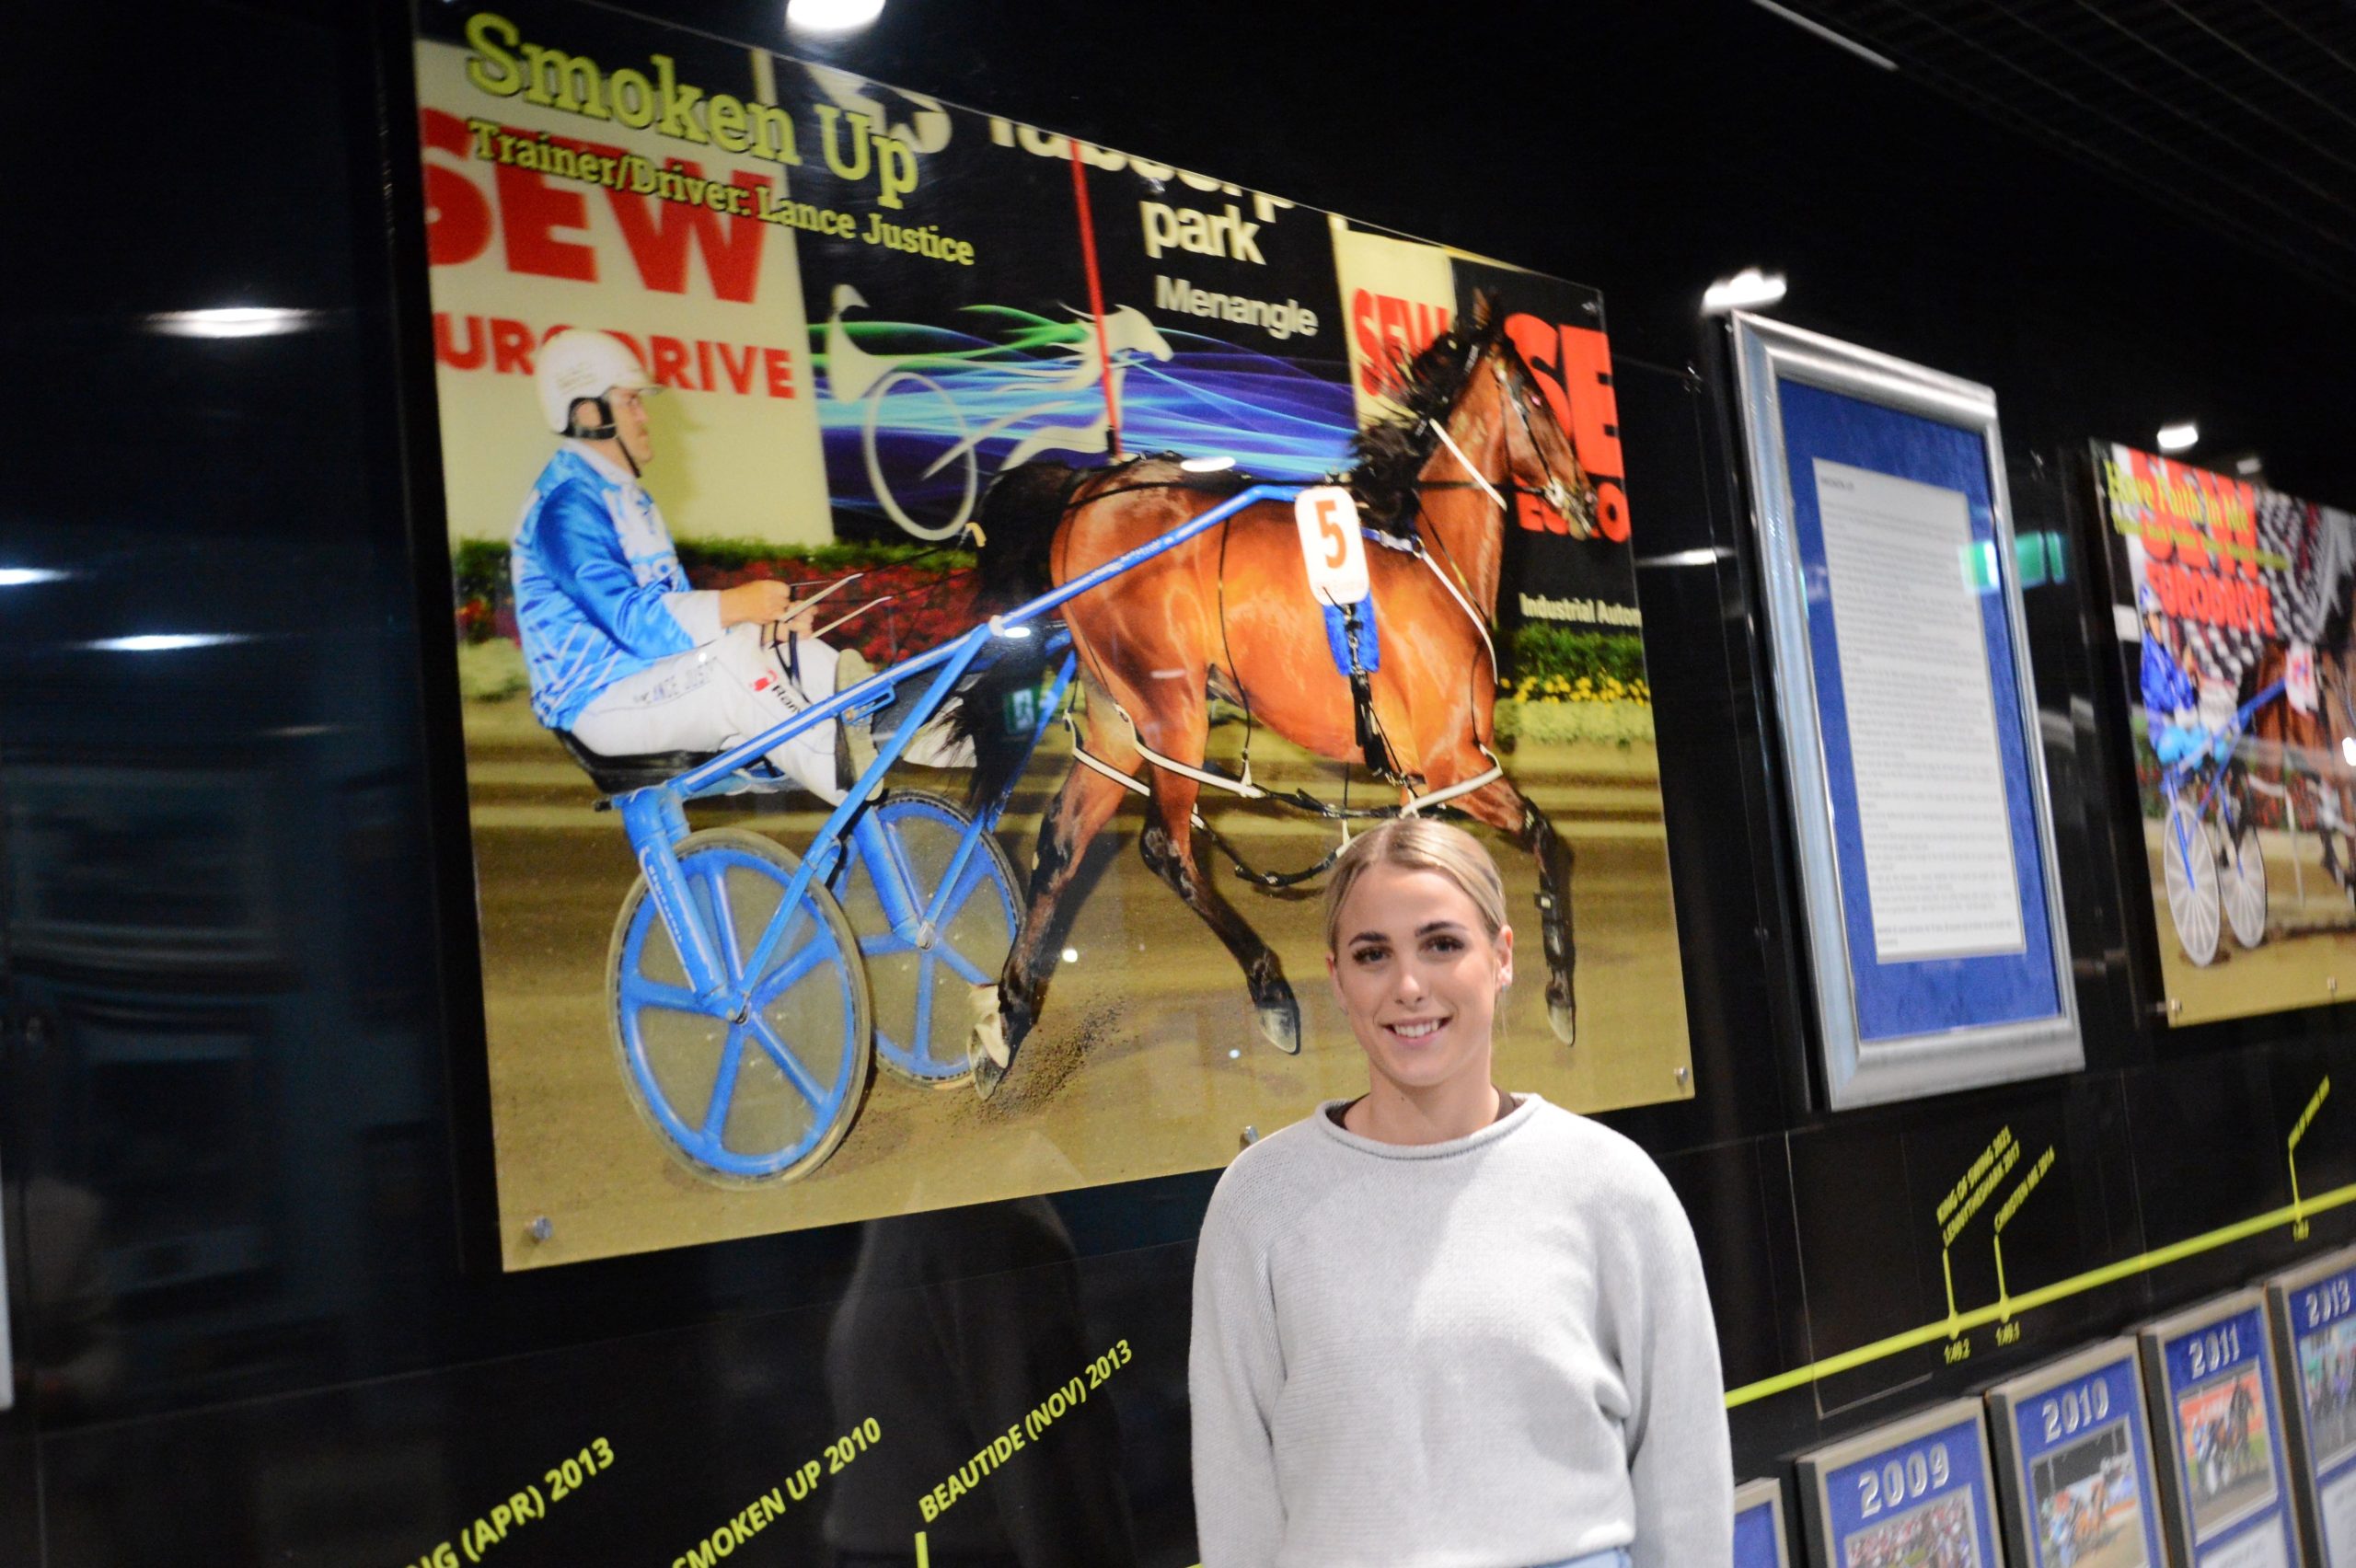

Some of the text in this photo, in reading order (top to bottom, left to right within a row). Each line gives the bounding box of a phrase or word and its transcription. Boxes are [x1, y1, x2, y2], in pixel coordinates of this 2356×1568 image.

[465, 12, 803, 167] Smoken
[814, 104, 920, 210] Up
[468, 117, 975, 266] Trainer/Driver: Lance Justice
[1138, 200, 1266, 265] park
[1155, 274, 1319, 340] Menangle
[1314, 500, 1346, 569] 5
[1519, 592, 1596, 623] Industrial
[2189, 1323, 2240, 1379] 2011
[918, 1339, 1133, 1523] BEAUTIDE (NOV) 2013
[2042, 1378, 2109, 1444] 2010
[785, 1460, 821, 1501] UP
[824, 1417, 882, 1475] 2010
[1858, 1442, 1949, 1518] 2009
[461, 1436, 615, 1562] (APR) 2013
